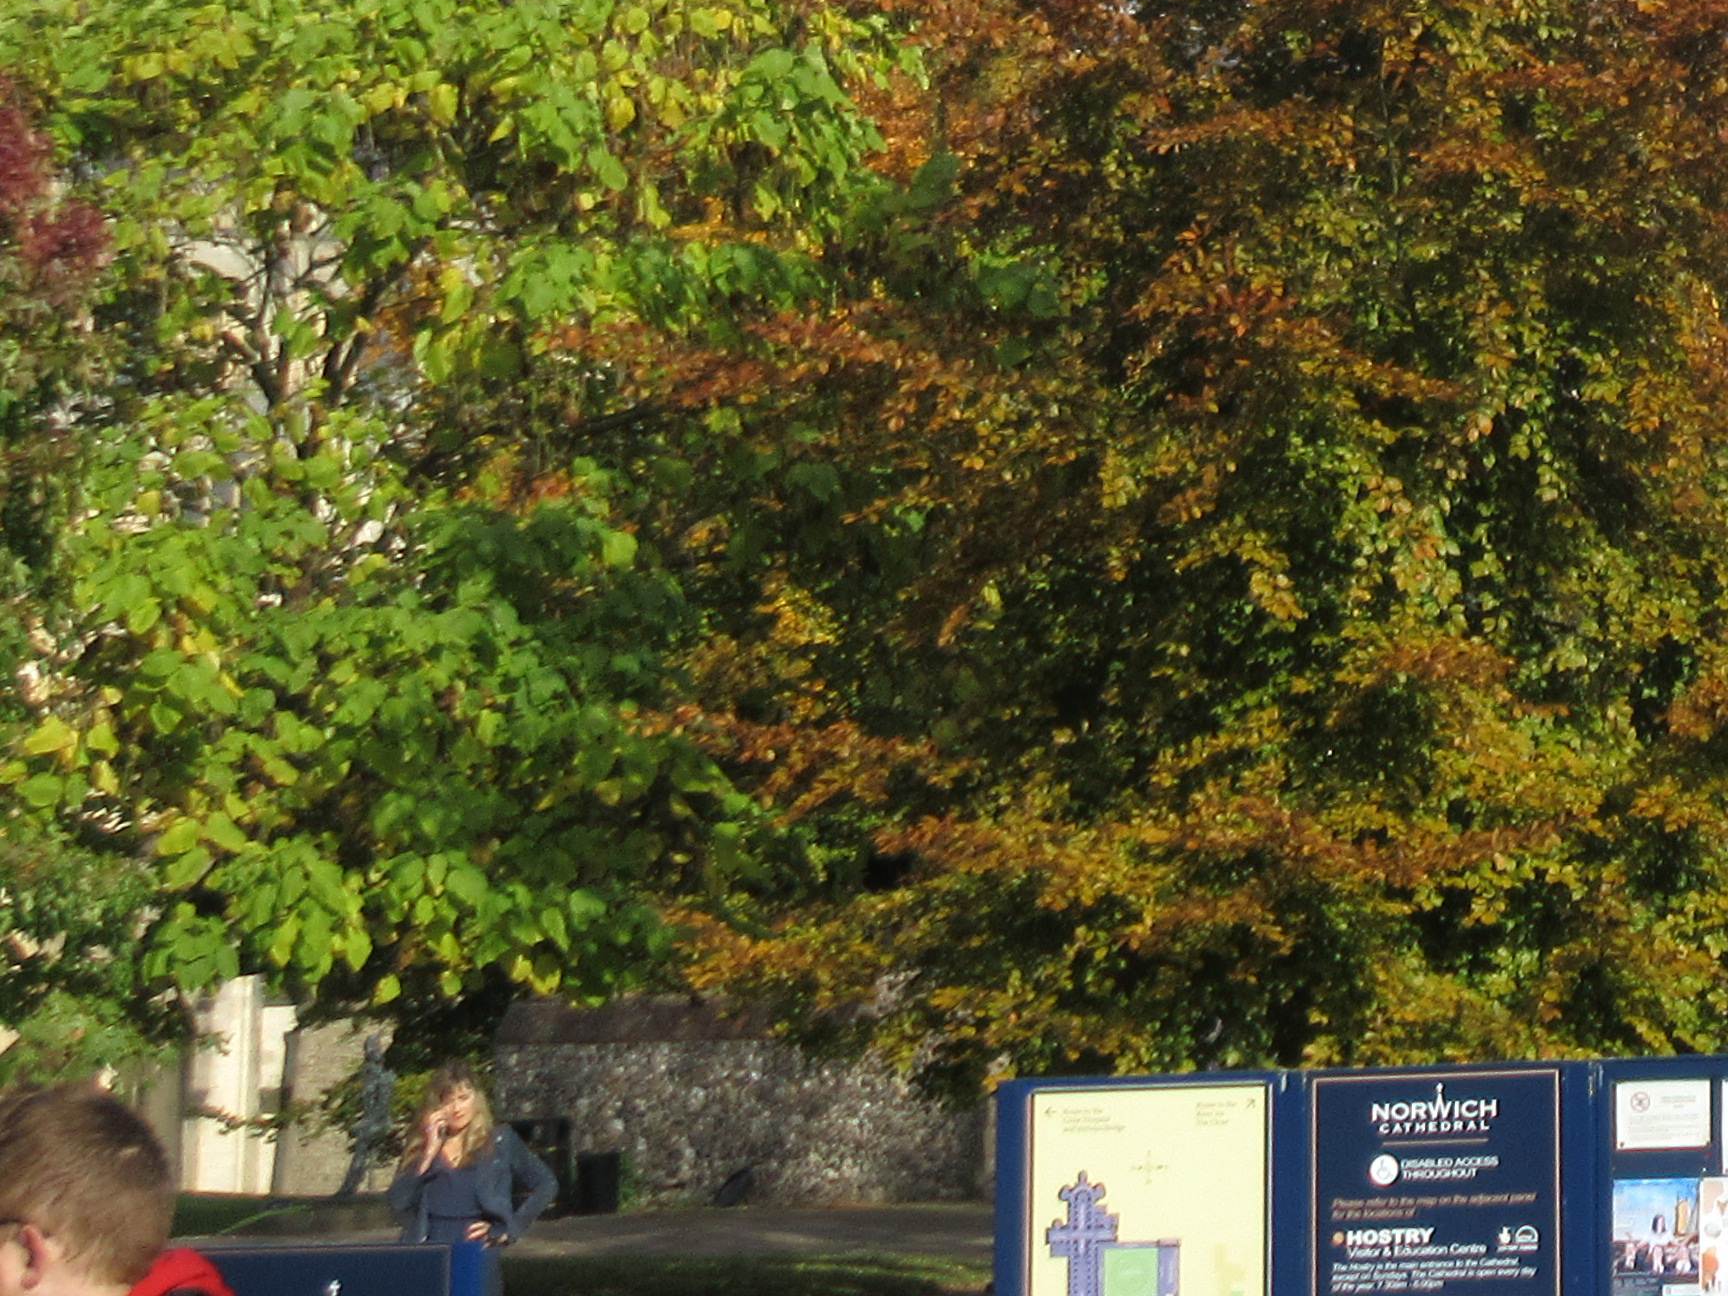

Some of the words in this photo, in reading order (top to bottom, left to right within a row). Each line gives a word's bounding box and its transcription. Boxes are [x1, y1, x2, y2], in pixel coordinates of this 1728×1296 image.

[1372, 1096, 1498, 1122] NORWICH
[1379, 1120, 1490, 1135] CATHEDRAL
[1401, 1157, 1454, 1169] DISABLED
[1455, 1155, 1499, 1168] ACCESS
[1403, 1167, 1478, 1180] THROUGHOUT
[1346, 1226, 1435, 1246] HOSTRY
[1347, 1246, 1381, 1259] Visitor
[1382, 1245, 1392, 1257] &
[1393, 1244, 1448, 1257] Education
[1449, 1242, 1487, 1256] Centre
